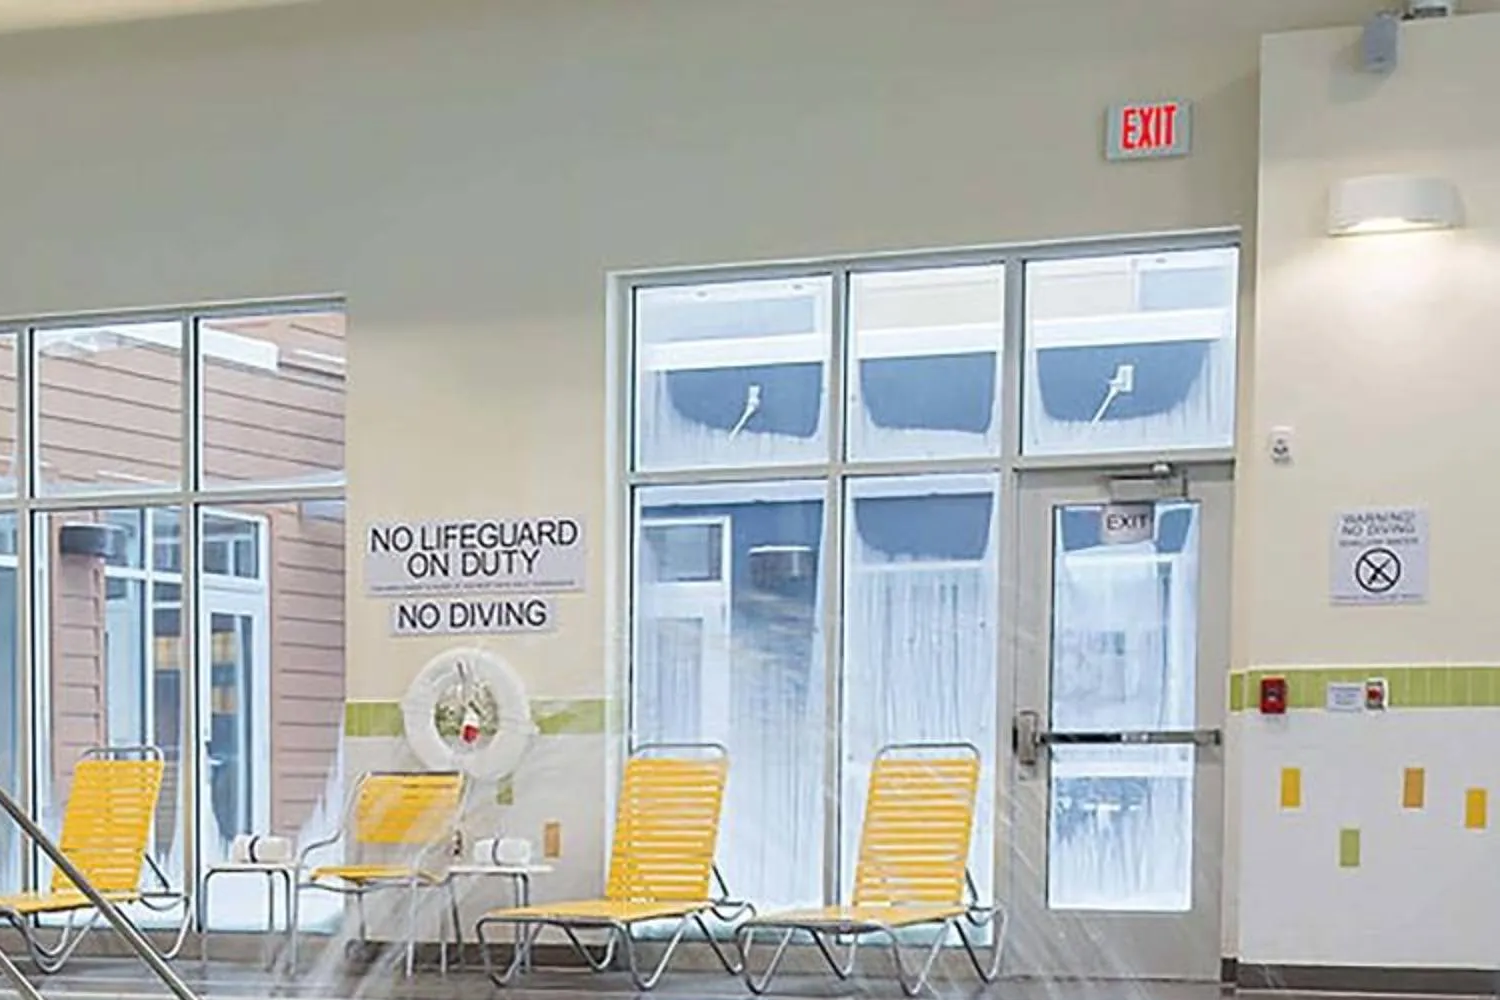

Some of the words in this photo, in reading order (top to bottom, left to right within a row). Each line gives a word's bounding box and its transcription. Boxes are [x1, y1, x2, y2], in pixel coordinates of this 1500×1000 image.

[1123, 105, 1177, 149] EXIT
[371, 526, 413, 553] NO
[421, 520, 578, 551] LIFEGUARD
[1107, 513, 1148, 530] EXIT
[407, 553, 449, 578] ON
[461, 549, 540, 577] DUTY
[398, 602, 440, 630] NO
[450, 600, 547, 628] DIVING
